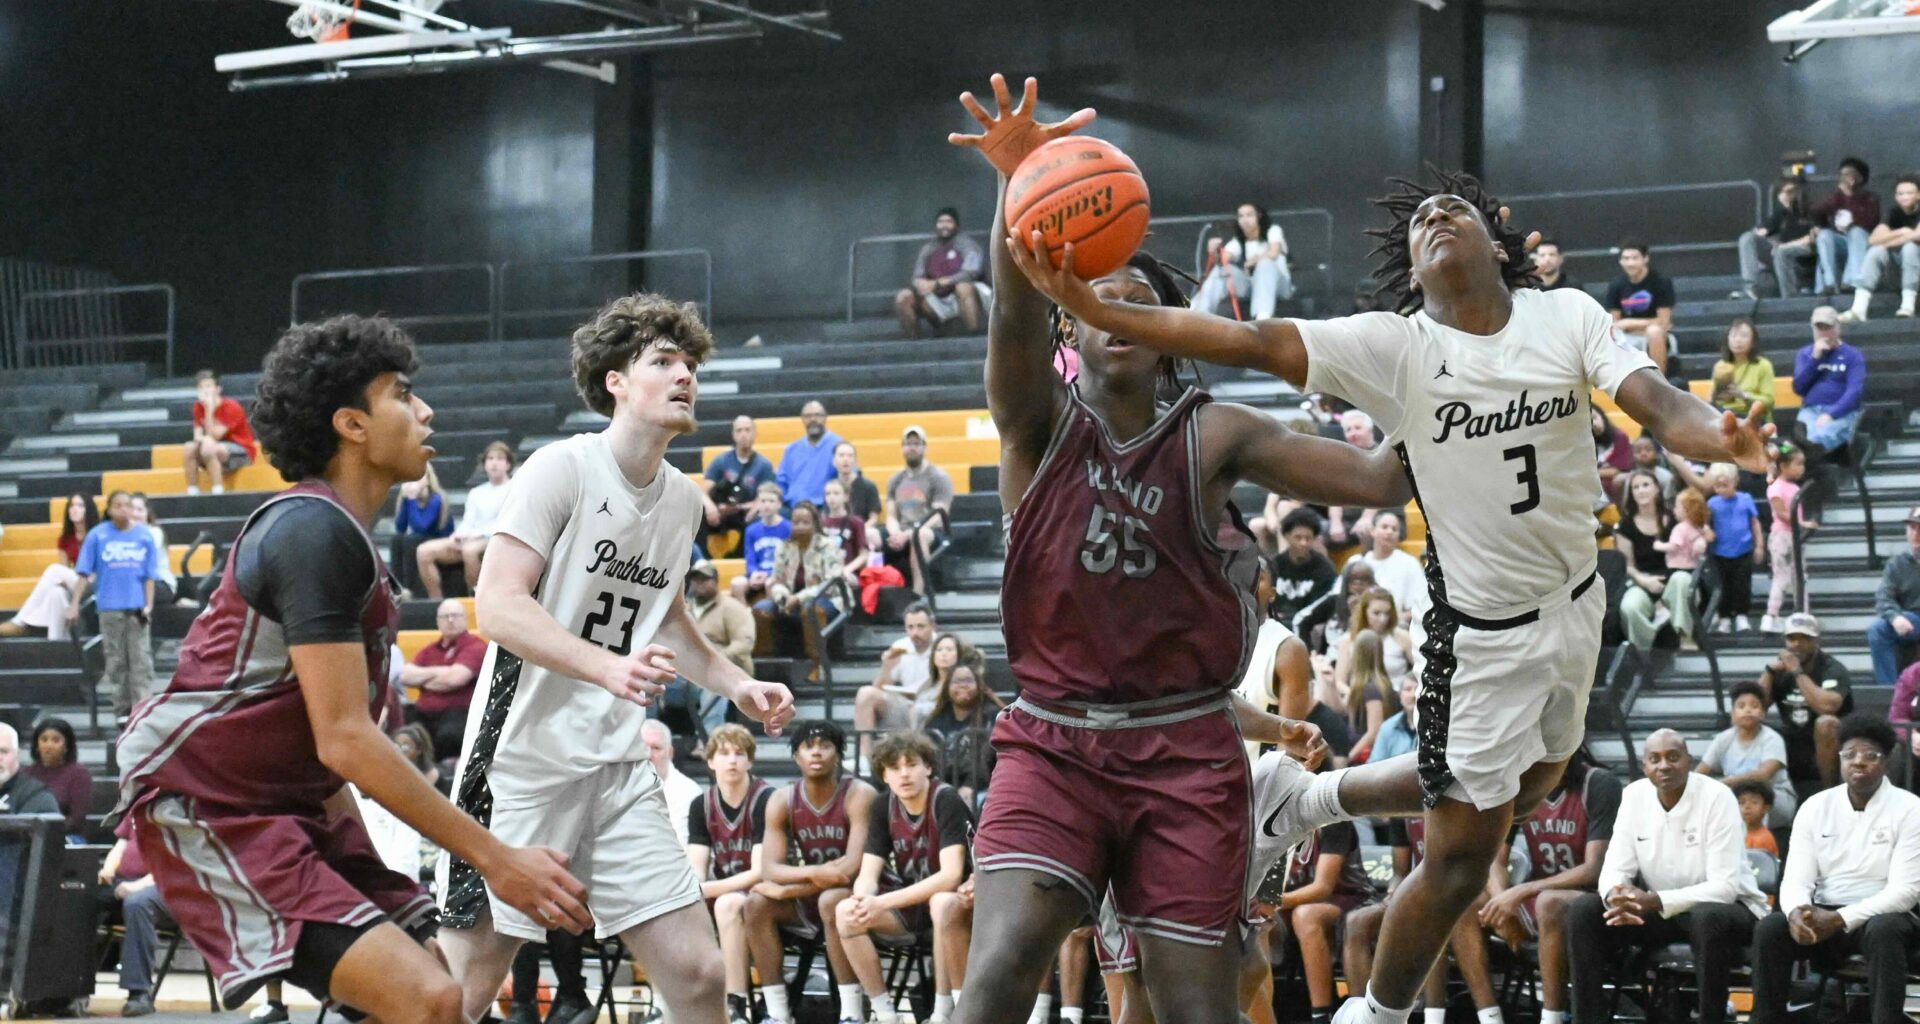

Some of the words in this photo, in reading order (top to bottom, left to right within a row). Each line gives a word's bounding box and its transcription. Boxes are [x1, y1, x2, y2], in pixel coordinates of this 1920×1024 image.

[1432, 390, 1578, 443] Panthers
[1503, 443, 1540, 515] 3
[586, 539, 669, 589] Panthers
[1081, 503, 1157, 578] 55
[581, 591, 641, 656] 23
[797, 824, 844, 842] PLANO
[1538, 842, 1576, 874] 33
